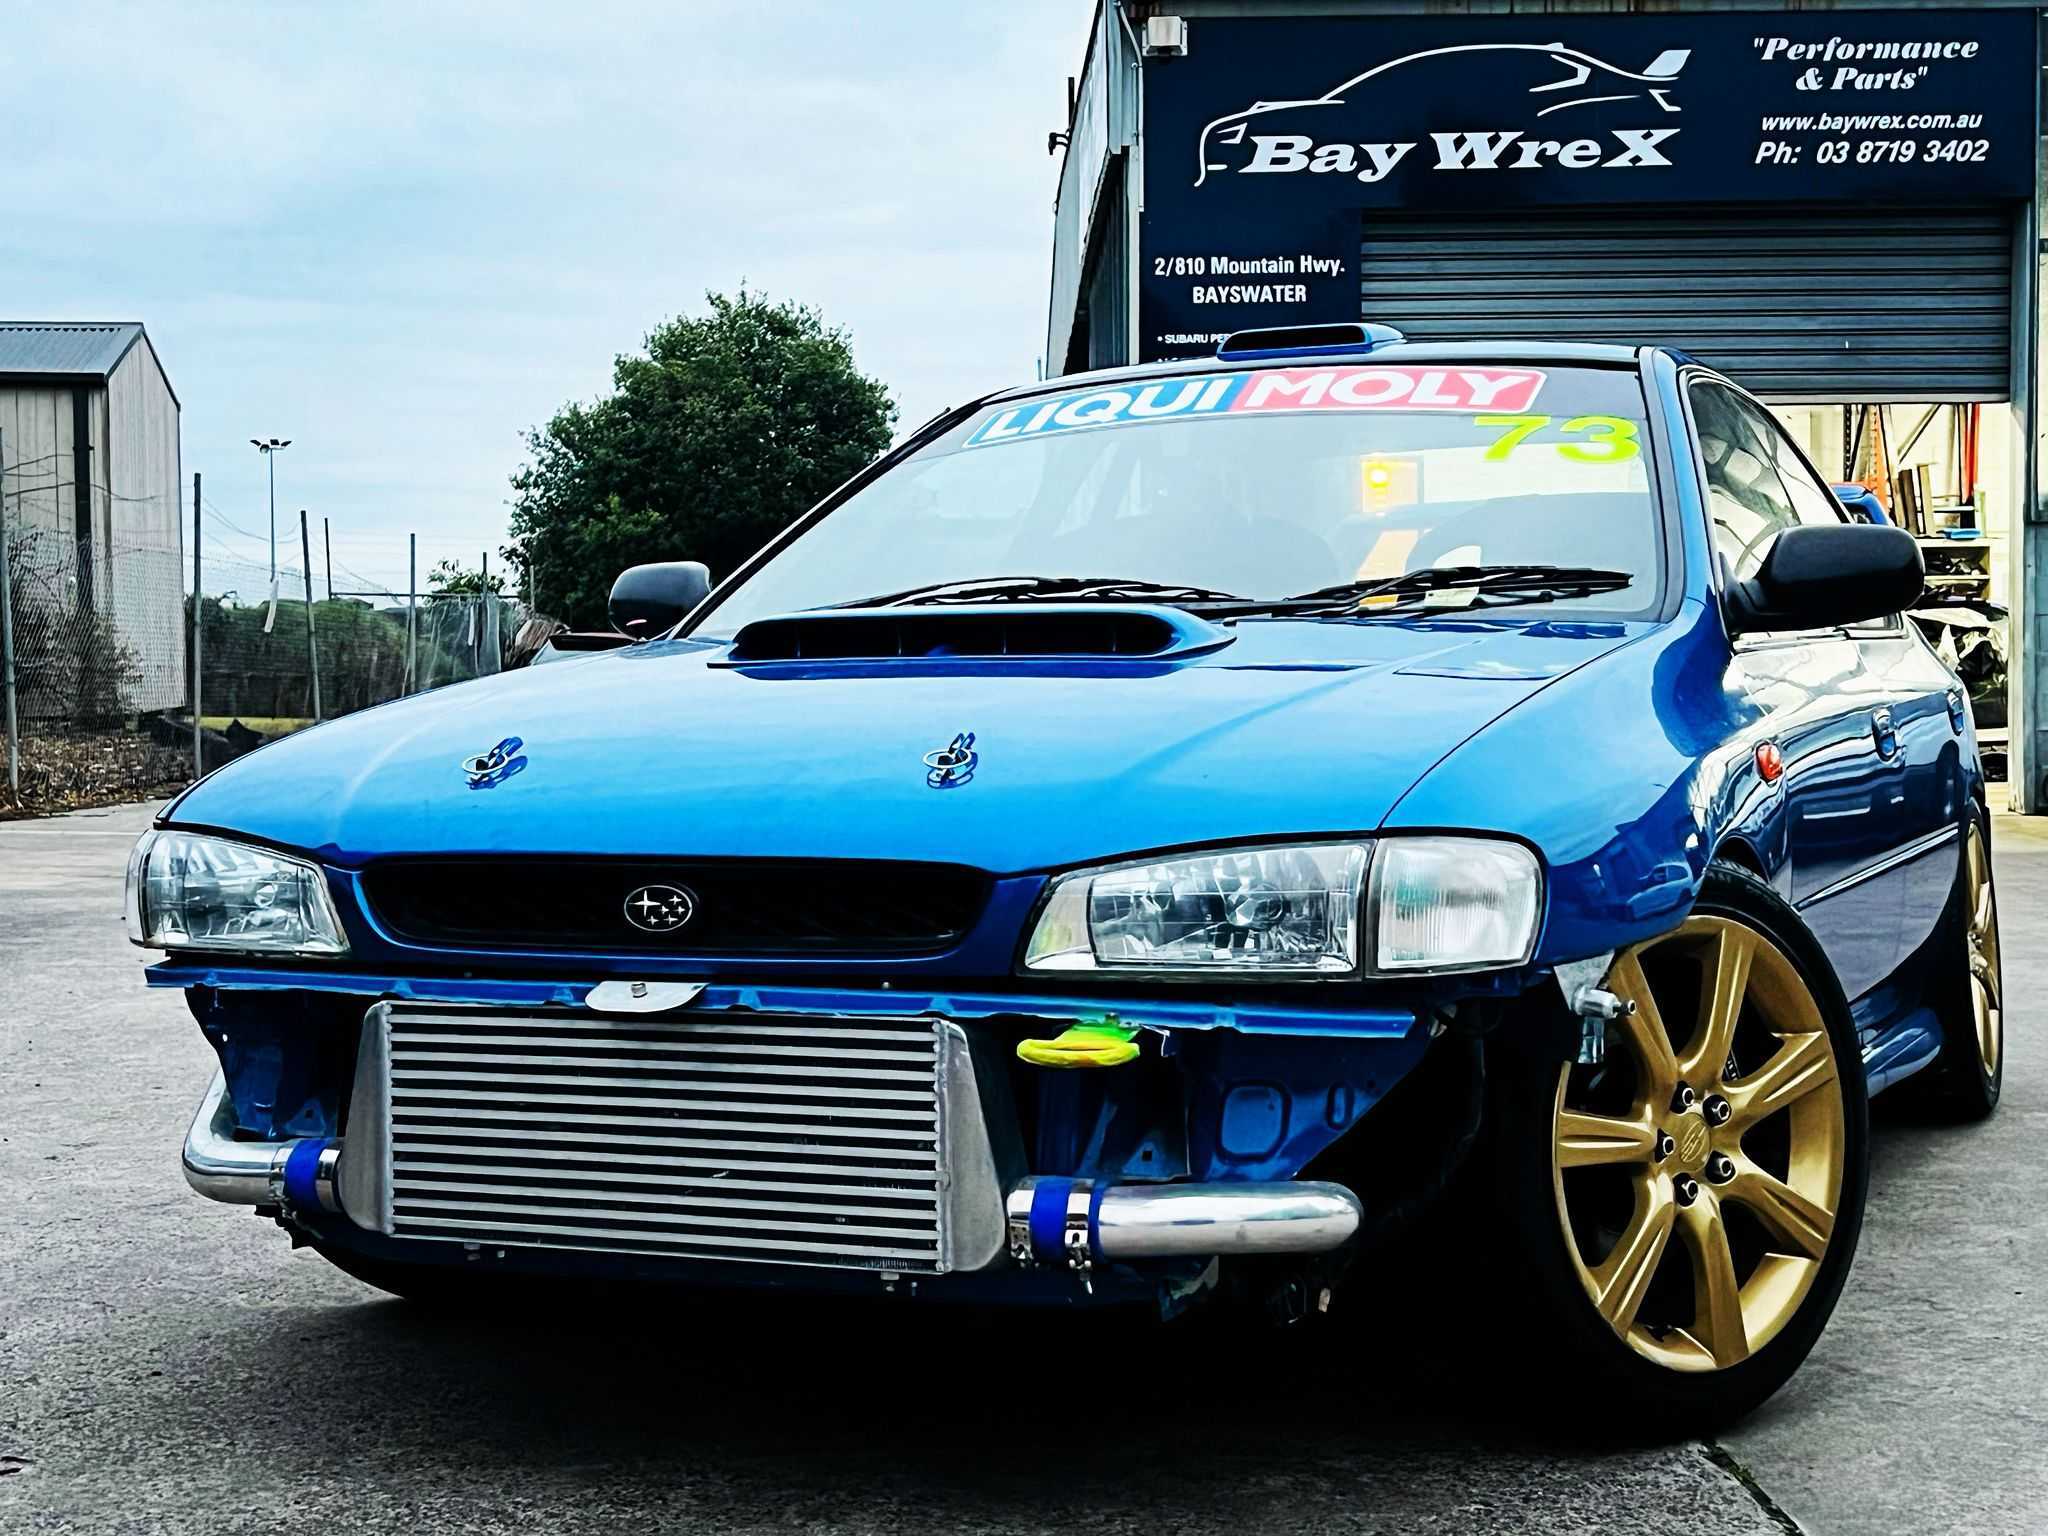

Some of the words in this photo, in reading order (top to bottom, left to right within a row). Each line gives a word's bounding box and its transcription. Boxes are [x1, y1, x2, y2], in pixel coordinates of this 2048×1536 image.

[1753, 36, 1979, 61] "Performance
[1795, 67, 1824, 90] &
[1830, 66, 1928, 90] Parts"
[1761, 112, 1983, 134] www.baywrex.com.au
[1238, 135, 1417, 182] Bay
[1430, 129, 1681, 170] WreX
[1754, 141, 1802, 164] Ph:
[1816, 141, 1850, 164] 03
[1855, 140, 1917, 163] 8719
[1922, 139, 1990, 162] 3402
[1154, 257, 1206, 277] 2/810
[1210, 256, 1295, 275] Mountain
[1300, 255, 1345, 277] Hwy.
[1192, 285, 1307, 304] BAYSWATER
[1164, 333, 1208, 344] SUBARU
[978, 378, 1234, 441] LIQUI
[1244, 371, 1528, 408] MOLY
[1473, 414, 1640, 463] 73
